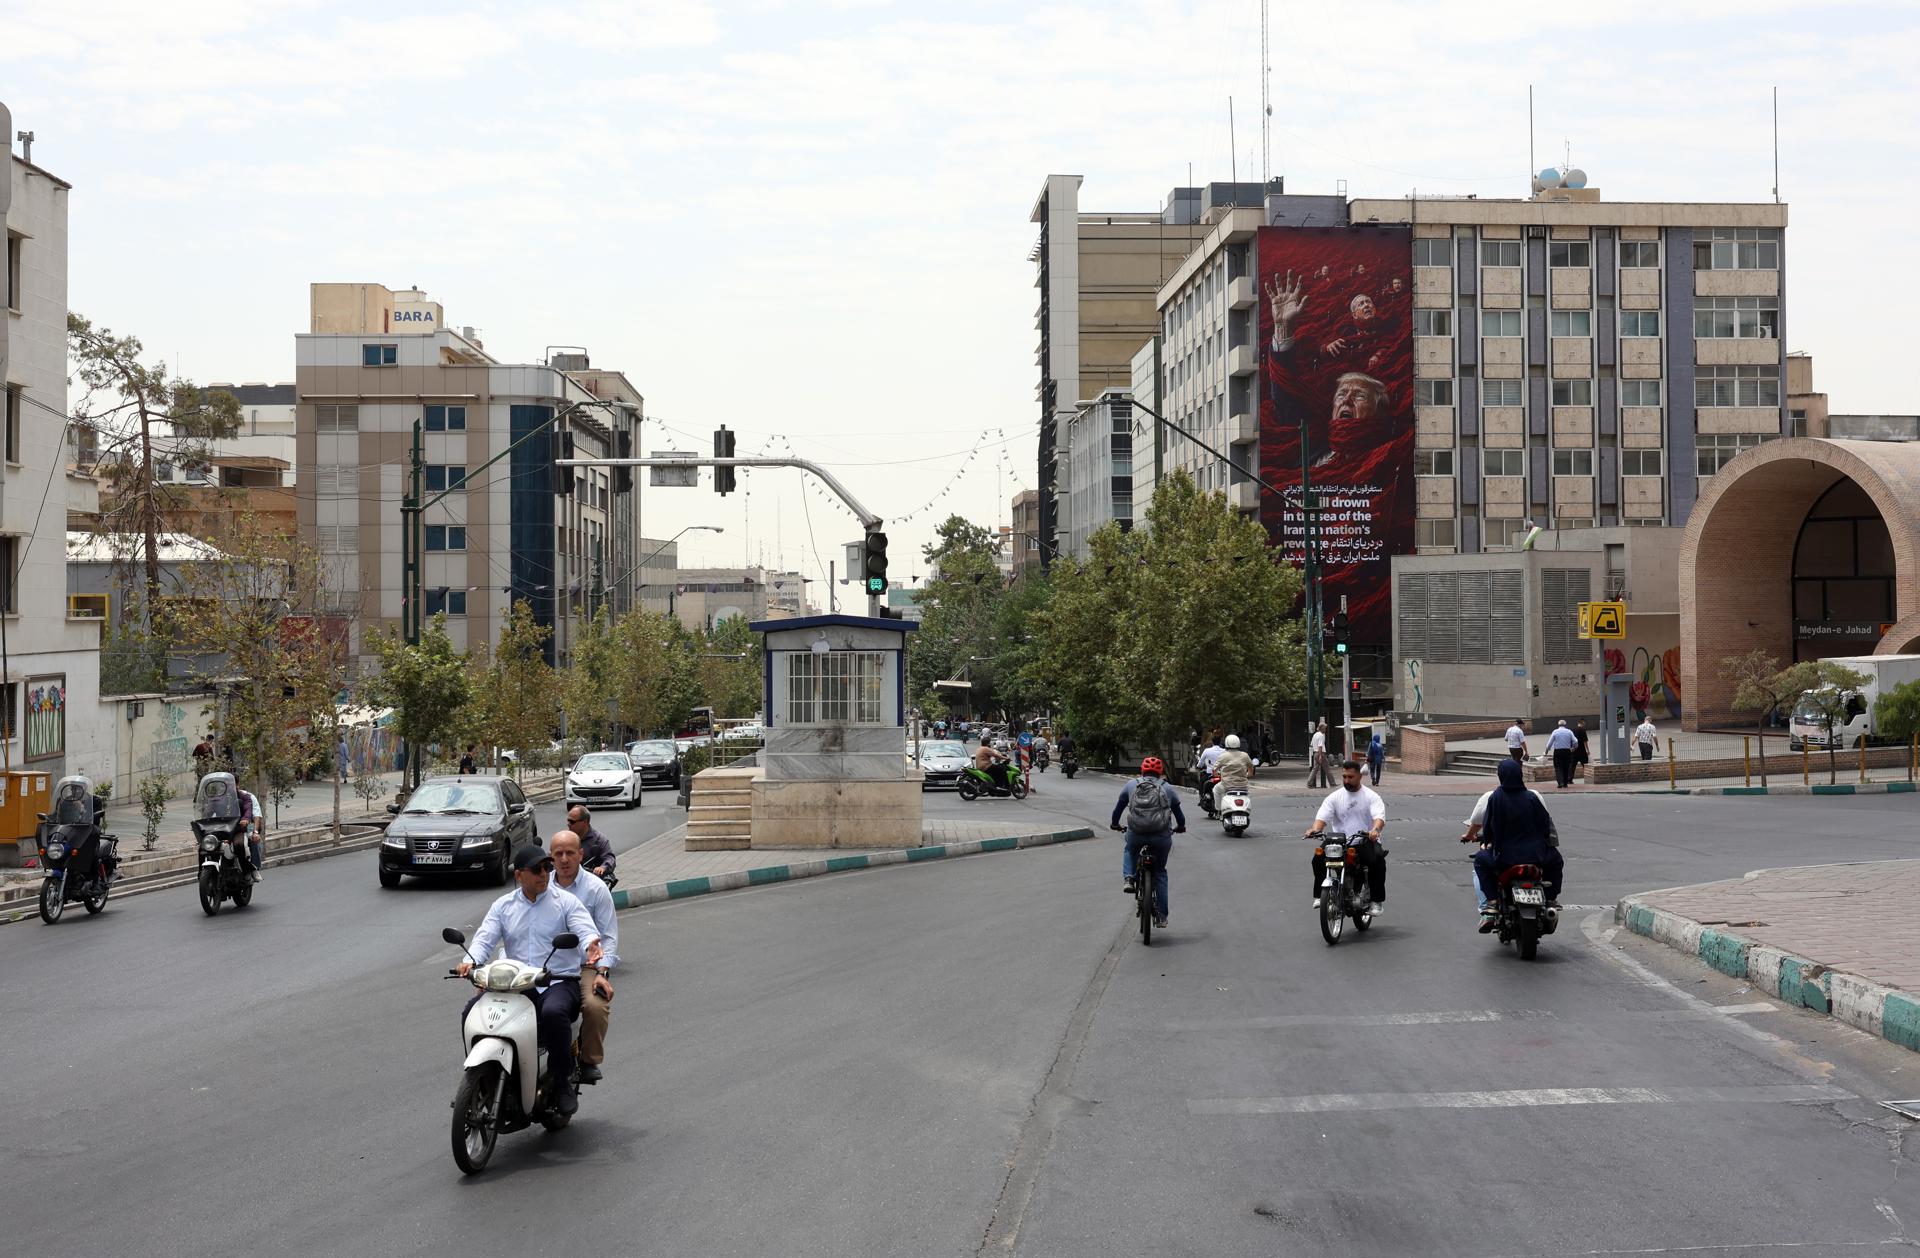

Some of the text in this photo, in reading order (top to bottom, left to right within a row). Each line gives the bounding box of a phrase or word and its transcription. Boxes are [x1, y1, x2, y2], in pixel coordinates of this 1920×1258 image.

[394, 311, 433, 321] BARA
[1318, 496, 1330, 508] ill
[1331, 497, 1370, 508] drown
[1283, 510, 1295, 521] in
[1319, 513, 1338, 521] sea
[1338, 511, 1351, 521] of
[1353, 511, 1372, 521] the
[1283, 524, 1370, 535] Iranan nation's
[1330, 538, 1353, 551] انتقام
[1374, 539, 1384, 550] در
[1325, 551, 1341, 564] غرق
[1342, 551, 1361, 564] ایران
[1361, 551, 1380, 561] ملت
[1799, 625, 1872, 636] Meydan-e Jahad
